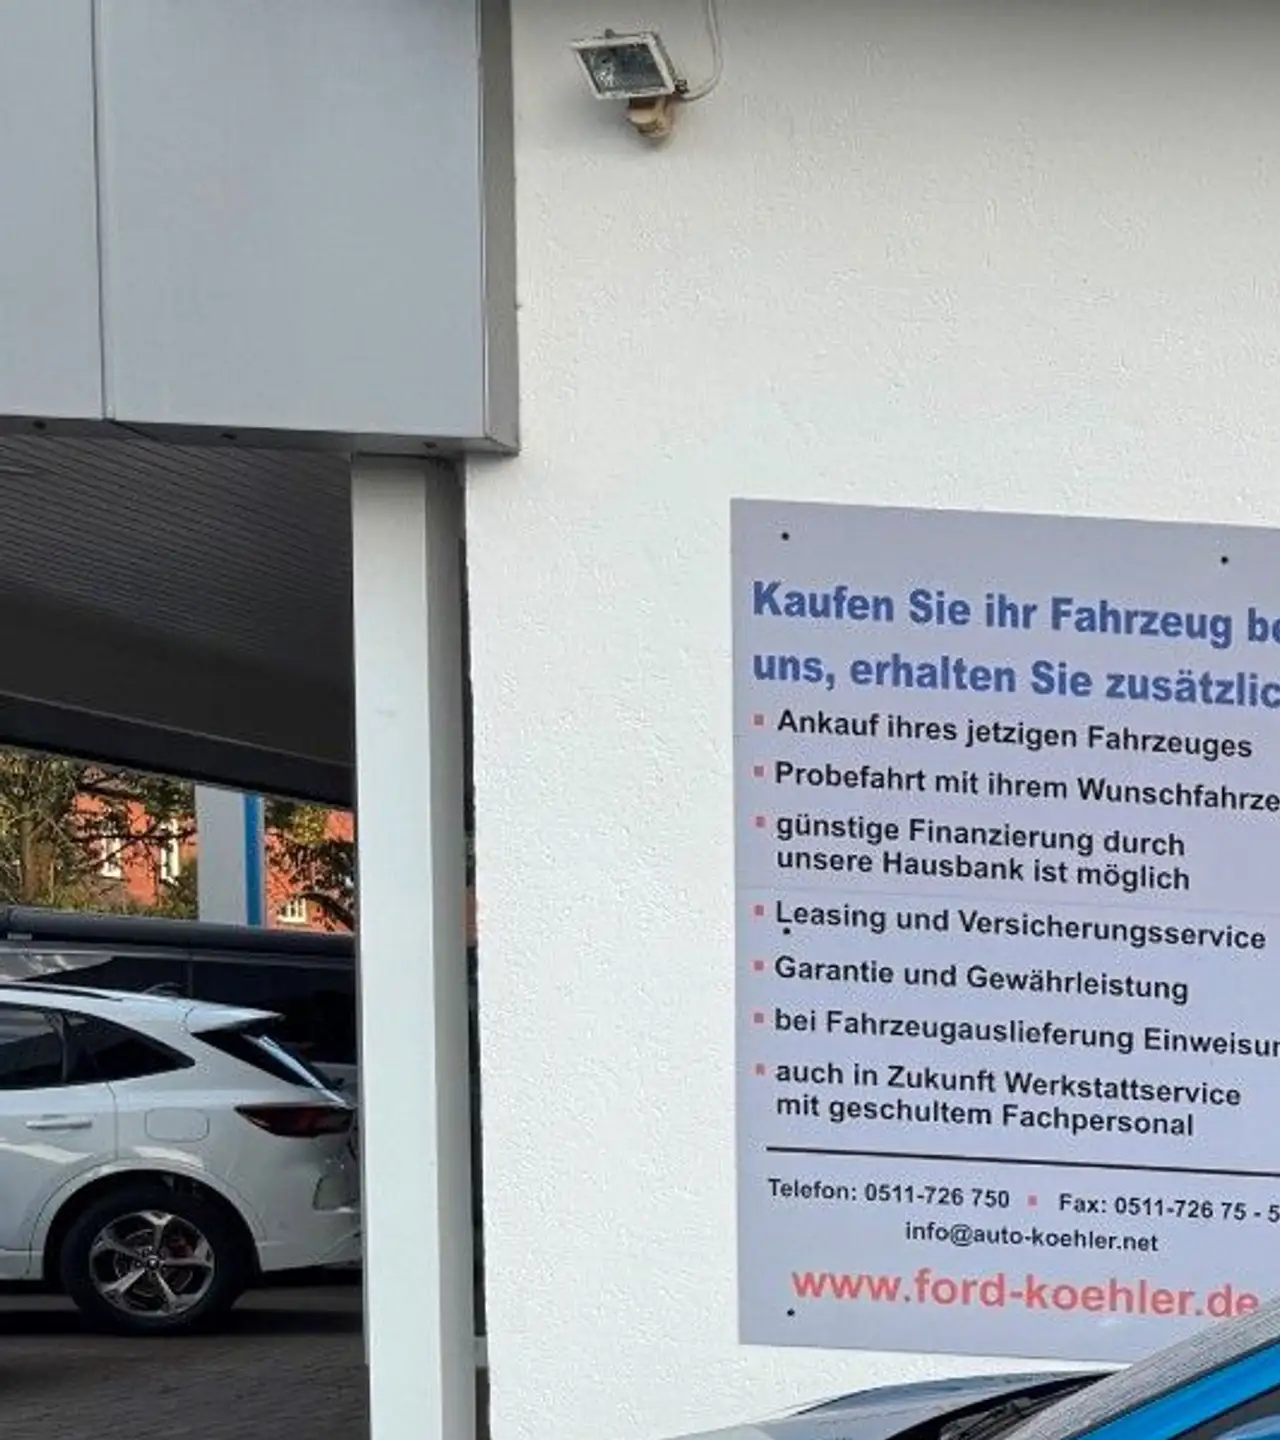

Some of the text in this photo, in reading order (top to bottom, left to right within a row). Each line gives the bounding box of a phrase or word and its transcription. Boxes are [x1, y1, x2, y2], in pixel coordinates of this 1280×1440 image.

[754, 581, 893, 621] Kaufen
[910, 589, 970, 625] Sie
[986, 593, 1037, 629] ihr
[1052, 597, 1232, 649] Fahrzeug
[754, 653, 835, 691] uns,
[850, 653, 1015, 692] erhalten
[1031, 660, 1092, 696] Sie
[778, 710, 1252, 759] Ankauf ihres jetzigen Fahrzeuges
[776, 761, 925, 791] Probefahrt
[936, 771, 978, 794] mit
[989, 772, 1066, 799] ihrem
[777, 814, 1184, 856] günstige Finanzierung durch
[778, 851, 1189, 893] unsere Hausbank ist möglich
[777, 901, 1265, 949] Leasing und Versicherungsservice
[775, 955, 1187, 1005] Garantie und Gewährleistung
[776, 1008, 815, 1031] bei
[827, 1010, 1133, 1054] Fahrzeugauslieferung
[776, 1063, 1240, 1105] auch in Zukunft Werkstattservice
[778, 1094, 1192, 1136] mit geschultem Fachpersonal
[768, 1178, 856, 1200] Telefon:
[865, 1183, 963, 1206] 0511-726
[972, 1188, 1009, 1208] 750
[1060, 1193, 1106, 1213] Fax:
[1115, 1197, 1213, 1219] 0511-726
[1221, 1202, 1246, 1220] 75
[906, 1222, 1158, 1251] info@auto-koehler.net
[792, 1268, 1259, 1318] www.ford-koehler.de
